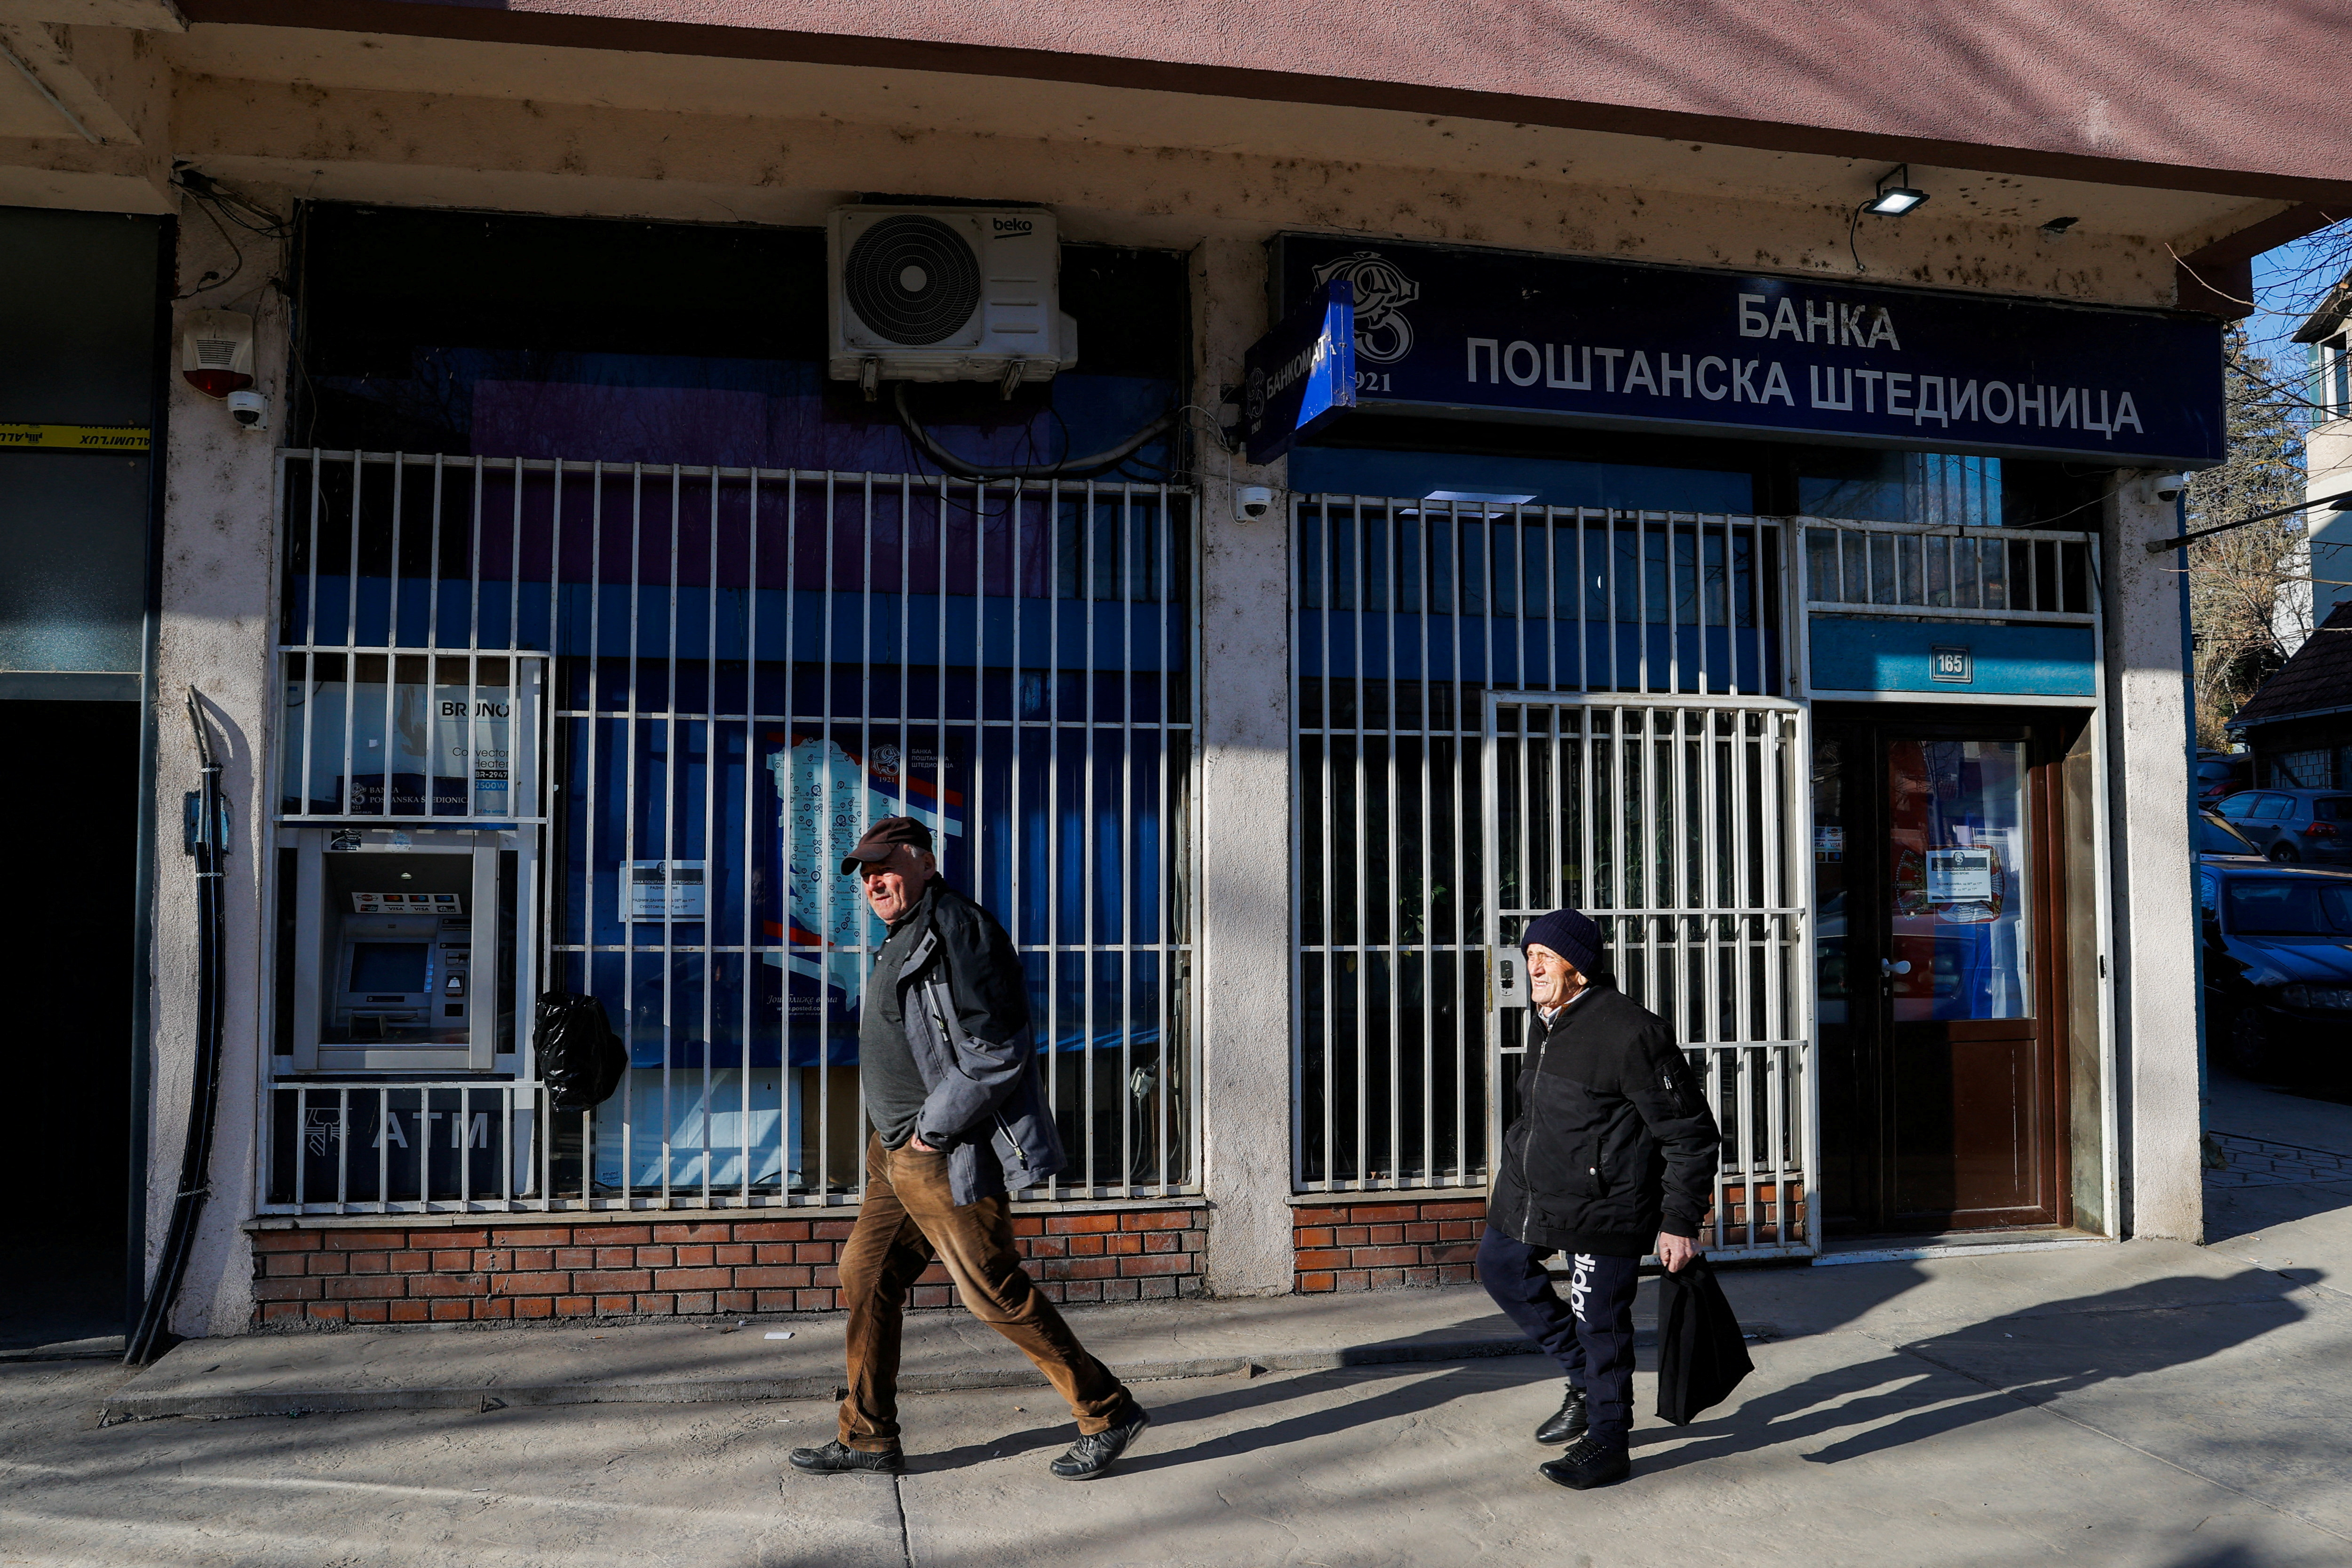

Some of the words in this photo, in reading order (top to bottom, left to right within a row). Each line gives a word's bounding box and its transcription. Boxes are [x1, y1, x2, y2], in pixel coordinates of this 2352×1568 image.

[993, 218, 1032, 231] beko
[1739, 293, 1900, 351] БАНКА
[1266, 334, 1327, 400] БАНКОМАТ
[1354, 371, 1392, 392] 921
[1467, 337, 1795, 406] ПОШТАНСКА
[1810, 364, 2144, 440] ШТЕДИОНИЦА
[1251, 419, 1261, 435] 1921
[1939, 654, 1963, 673] 165
[453, 747, 509, 757] Covector
[372, 1112, 488, 1148] ATM
[1571, 1252, 1596, 1323] didas
